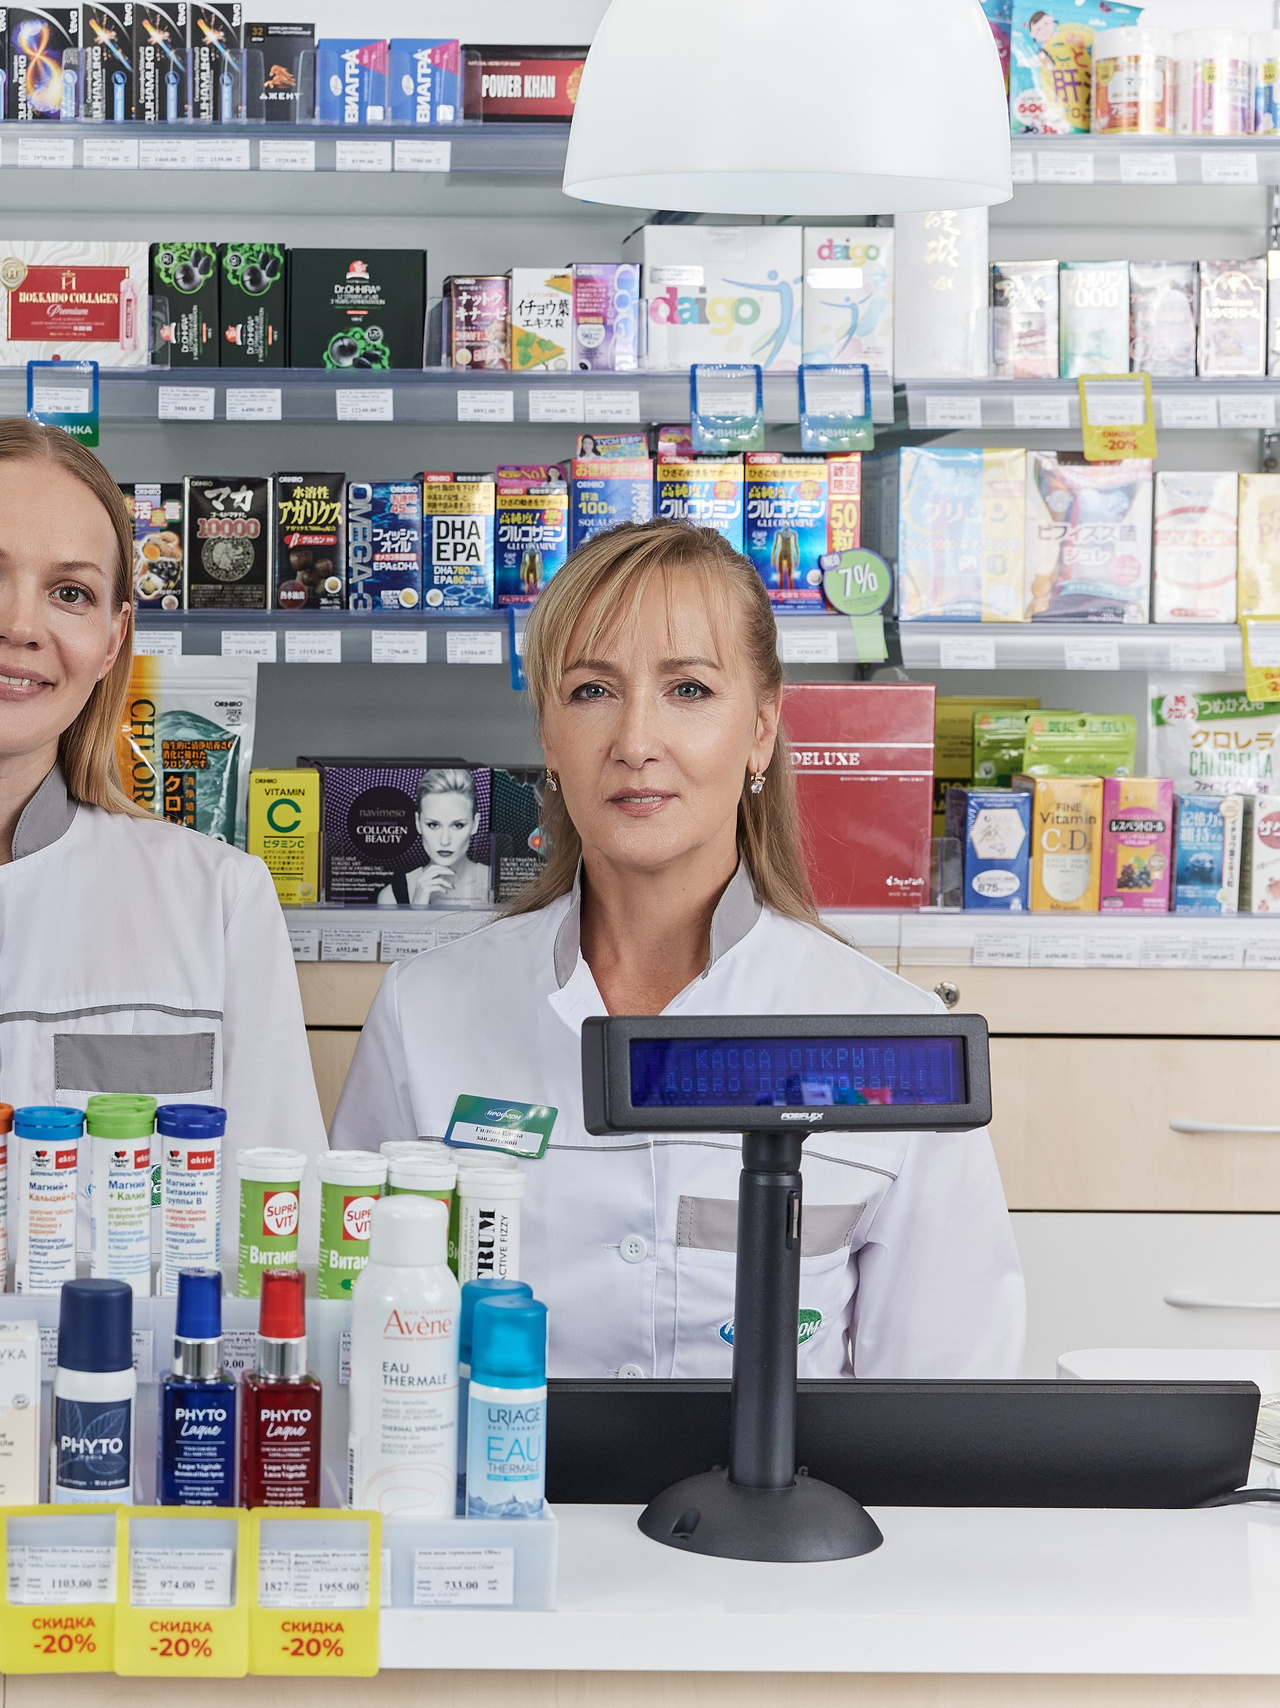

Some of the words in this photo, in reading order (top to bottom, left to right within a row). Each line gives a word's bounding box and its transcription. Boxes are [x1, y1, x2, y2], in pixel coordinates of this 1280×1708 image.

[345, 49, 359, 123] ВИАГРА
[417, 49, 432, 122] ВИАГРА
[482, 75, 521, 98] POWER
[524, 75, 556, 98] KHAN
[818, 239, 879, 267] daigo
[19, 292, 68, 303] HOKKAIDO
[71, 292, 118, 303] COLLAGEN
[459, 292, 502, 306] ナットウ
[47, 304, 89, 317] Premium
[456, 308, 507, 321] キナーゼ
[516, 300, 570, 316] イチョウ葉
[649, 287, 760, 335] daigo
[699, 429, 757, 438] НОВИНКА
[1103, 438, 1139, 453] -20%
[204, 487, 254, 512] マカ
[292, 486, 329, 499] 水溶性
[278, 500, 342, 524] アガリクス
[747, 500, 825, 519] グルコサミン
[831, 504, 857, 528] 50
[197, 519, 260, 538] 10000
[372, 529, 418, 541] フィッシュ
[436, 521, 481, 540] DHA
[498, 525, 566, 543] グルコサミン
[349, 483, 372, 611] OMEGA-3
[381, 541, 411, 552] オイル
[437, 543, 481, 561] EPA
[373, 561, 419, 571] EPA&DHA
[839, 564, 878, 596] 7%
[1191, 730, 1275, 749] クロレラ
[790, 752, 860, 766] DELUXE
[1190, 750, 1273, 779] CHLORELLA
[264, 788, 305, 796] VITAMIN
[267, 799, 302, 833] C
[1040, 812, 1097, 825] Vitamin
[356, 826, 407, 835] COLLAGEN
[263, 840, 305, 849] ビタミンC
[365, 834, 402, 843] BEAUTY
[697, 1049, 771, 1069] КАССА
[790, 1048, 896, 1069] ОТКРЫТА
[666, 1072, 741, 1093] Добро
[109, 1180, 146, 1190] Магний
[166, 1180, 195, 1189] Магний
[166, 1188, 209, 1196] Витамины
[118, 1191, 146, 1201] Калий
[267, 1202, 297, 1217] SUPRA
[275, 1215, 293, 1228] VIT
[500, 1215, 508, 1242] FIZZY
[383, 1310, 452, 1335] Avène
[382, 1362, 410, 1374] EAU
[382, 1373, 448, 1387] THERMALE
[175, 1408, 227, 1422] PHYTO
[261, 1409, 312, 1422] PHYTO
[487, 1407, 540, 1425] URIAGE
[180, 1421, 221, 1436] Laque
[266, 1422, 307, 1438] Laque
[61, 1436, 122, 1454] PHYTO
[487, 1436, 540, 1461] EAU
[488, 1463, 540, 1473] THERMALE
[51, 1579, 91, 1588] 1103.00
[160, 1581, 195, 1590] 974.00
[319, 1581, 359, 1591] 1955.00
[444, 1581, 479, 1590] 733.00
[32, 1618, 96, 1629] СКИДКА
[150, 1622, 213, 1632] СКИДКА
[281, 1622, 344, 1632] СКИДКА
[33, 1634, 96, 1655] -20%
[150, 1639, 212, 1657] -20%
[281, 1639, 343, 1657] -20%
